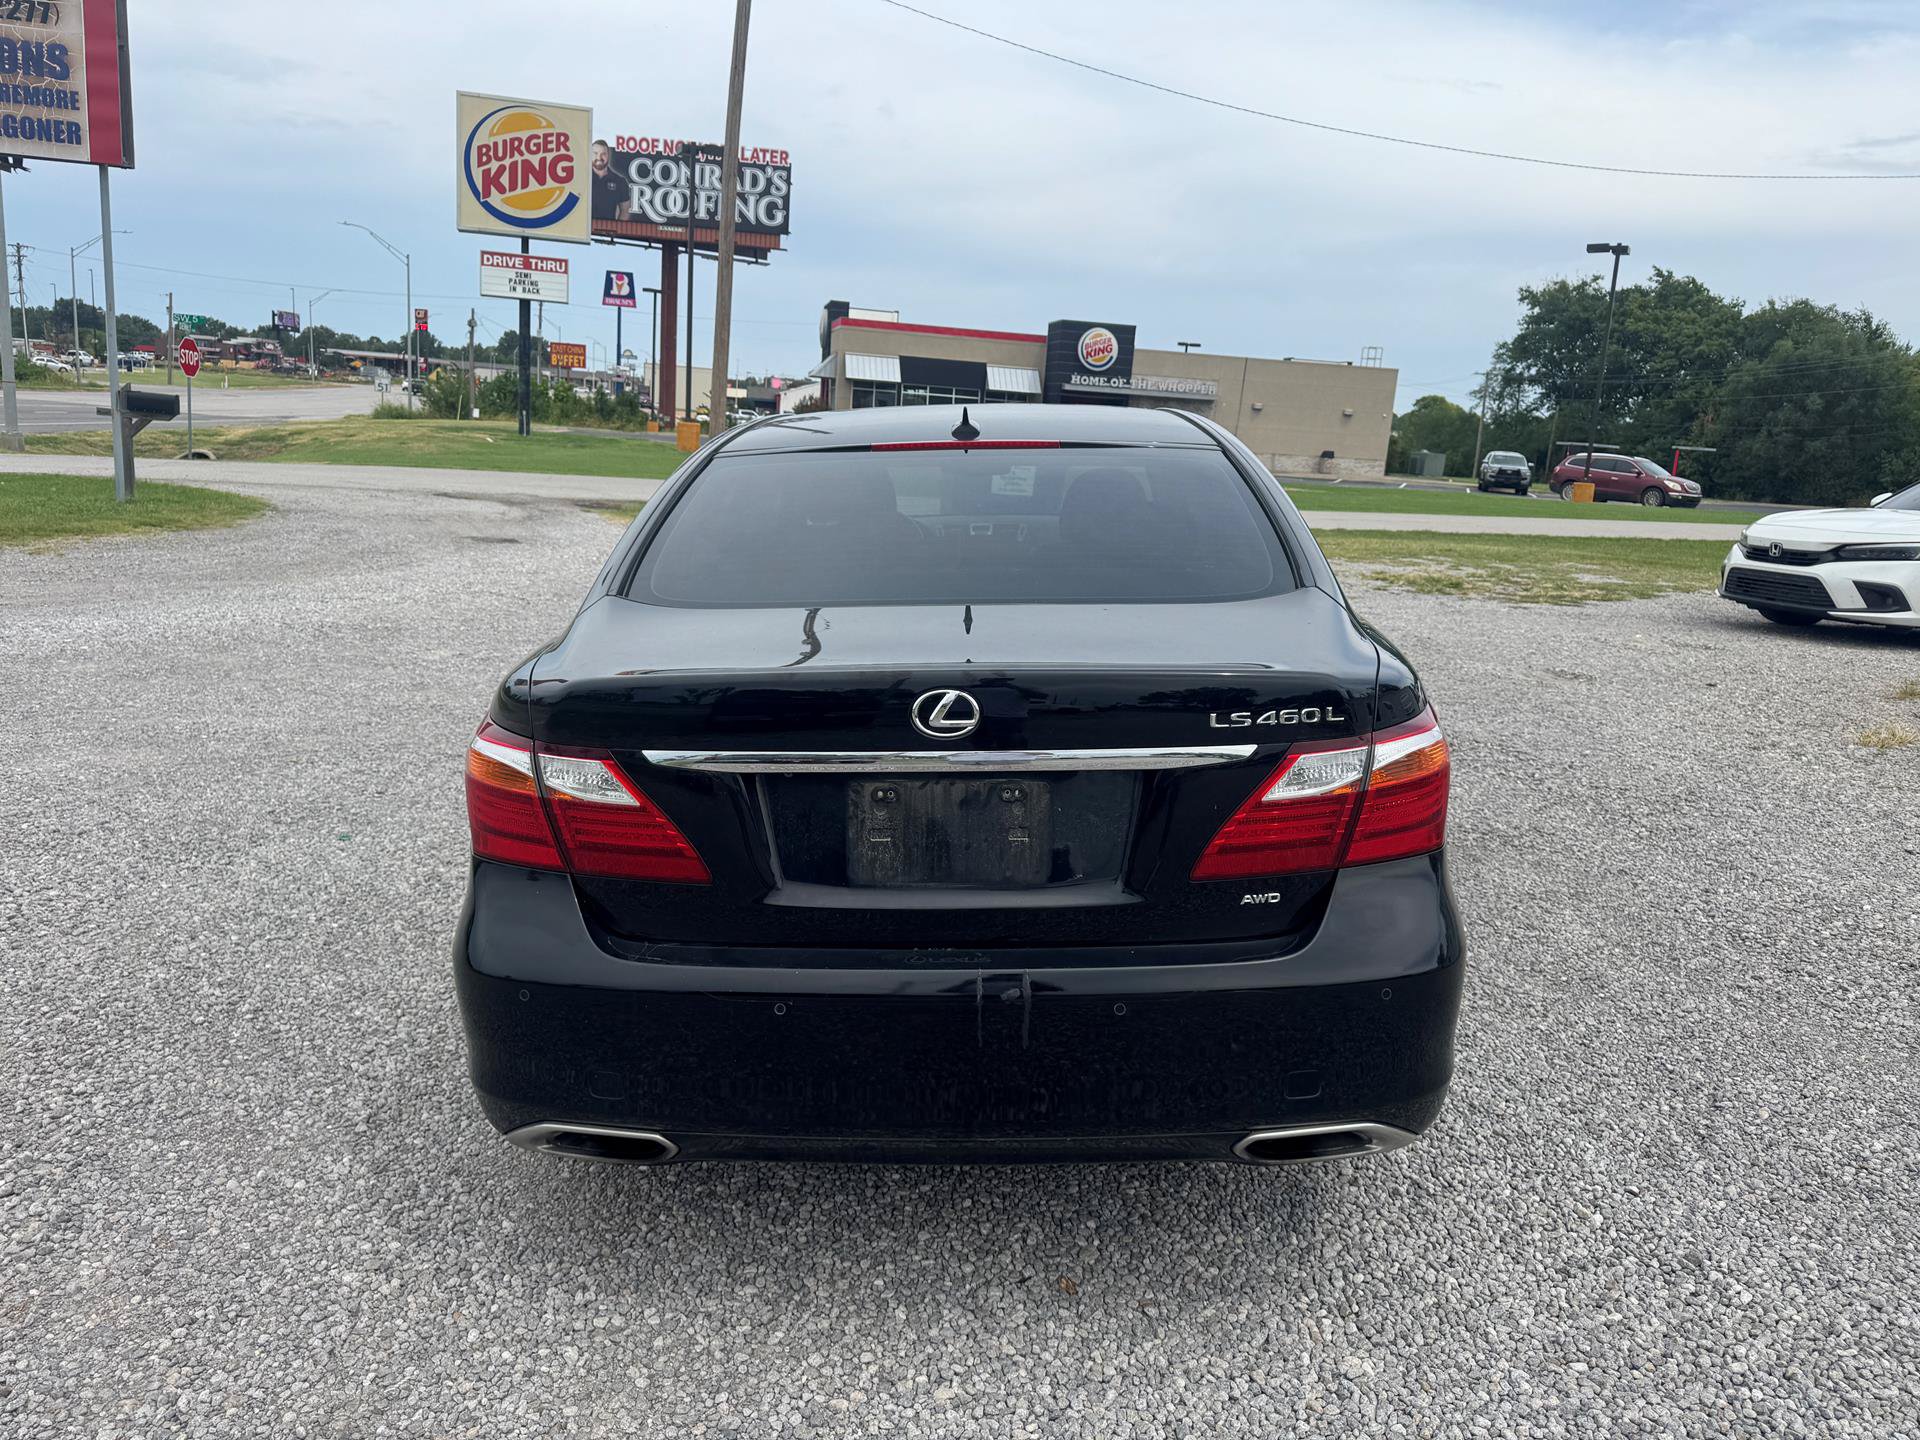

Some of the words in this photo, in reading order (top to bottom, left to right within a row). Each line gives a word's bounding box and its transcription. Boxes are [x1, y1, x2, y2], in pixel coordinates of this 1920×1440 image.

[0, 0, 60, 26] 277)
[0, 113, 82, 145] GONER
[477, 132, 570, 168] BURGER
[615, 134, 661, 154] ROOF
[740, 147, 790, 166] LATER
[481, 153, 575, 200] KING
[628, 157, 788, 197] CONRD'S
[483, 254, 524, 269] DRIVE
[529, 258, 566, 273] THRU
[508, 278, 539, 288] PARKING
[514, 271, 532, 280] SEMI
[522, 287, 541, 295] BACK
[1085, 337, 1113, 350] BURGER
[1085, 344, 1113, 360] KING
[180, 349, 199, 367] STOP
[551, 354, 585, 367] BUFFET
[1071, 374, 1109, 385] HOME
[1110, 378, 1129, 388] OF
[1159, 382, 1217, 395] WHOPPER
[1240, 892, 1281, 905] AWD
